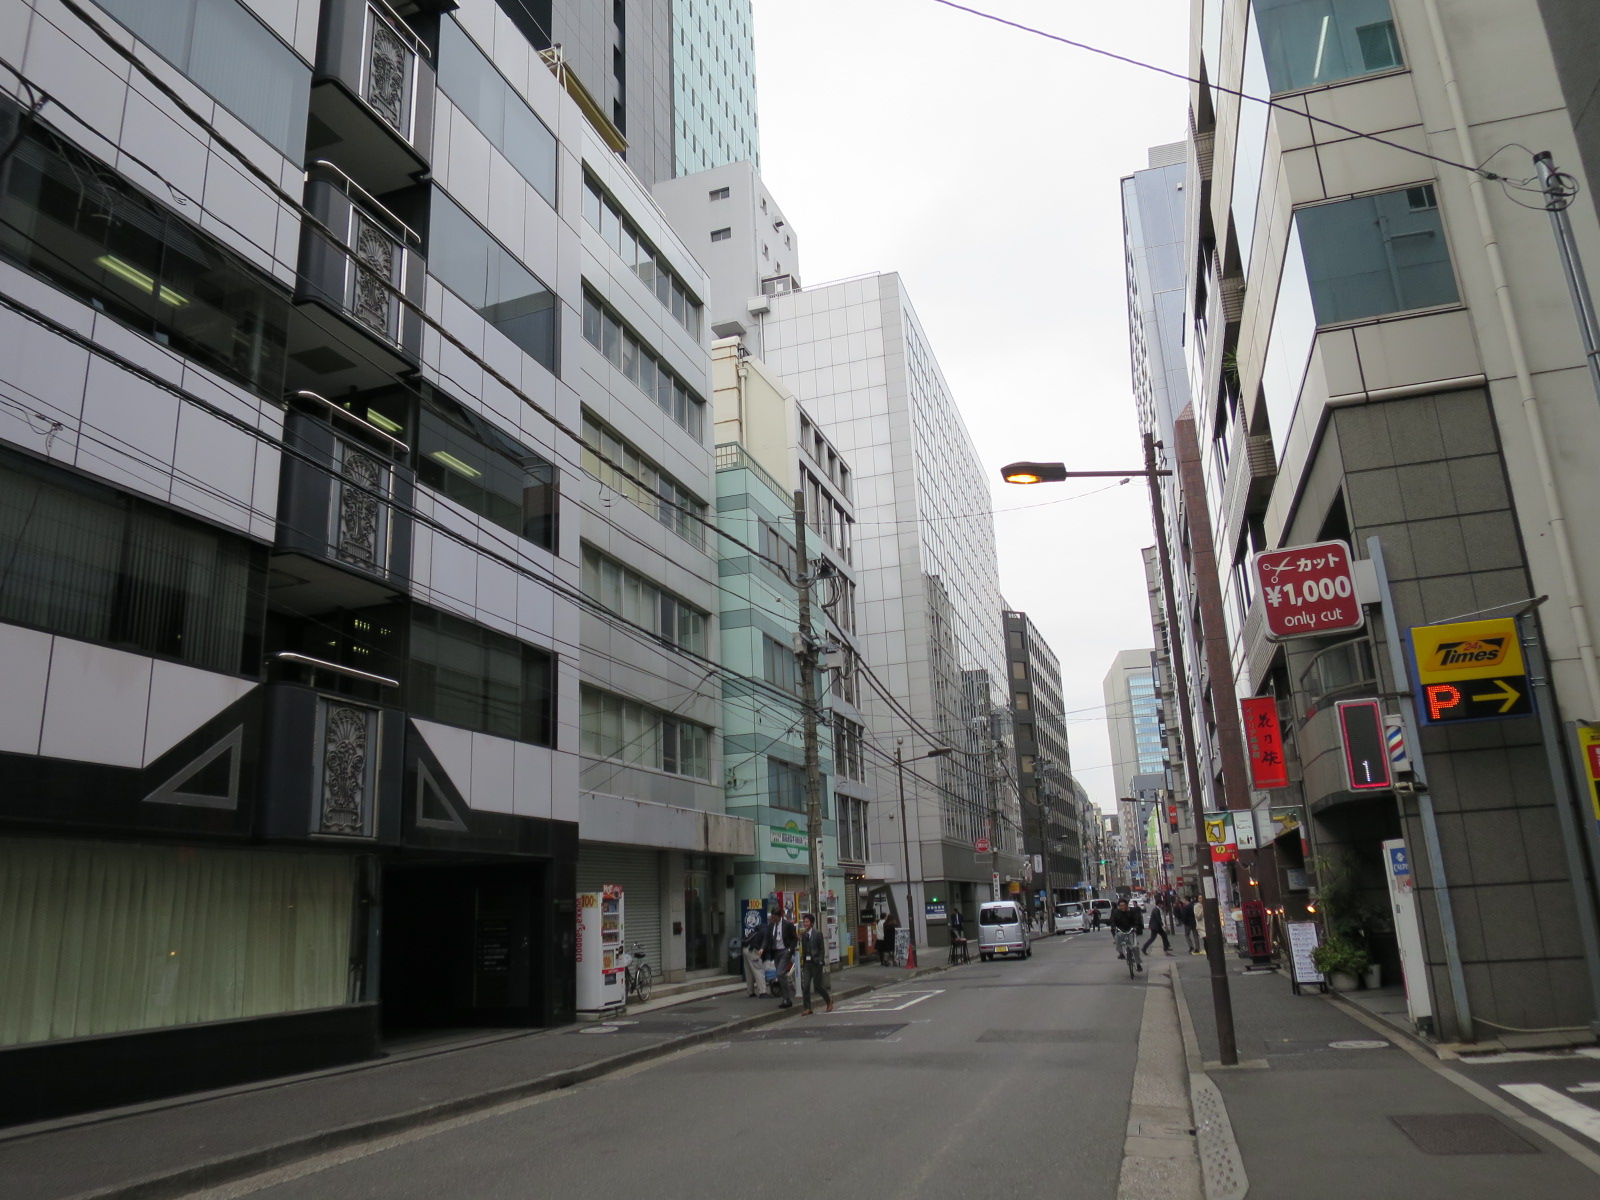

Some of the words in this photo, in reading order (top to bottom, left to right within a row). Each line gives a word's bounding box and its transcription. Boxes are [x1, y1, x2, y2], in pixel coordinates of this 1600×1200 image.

[1297, 553, 1339, 572] カット
[1265, 575, 1351, 607] ¥1,000
[1284, 611, 1316, 627] only
[1321, 608, 1343, 621] cut
[1436, 643, 1500, 666] Times
[1427, 684, 1461, 719] P
